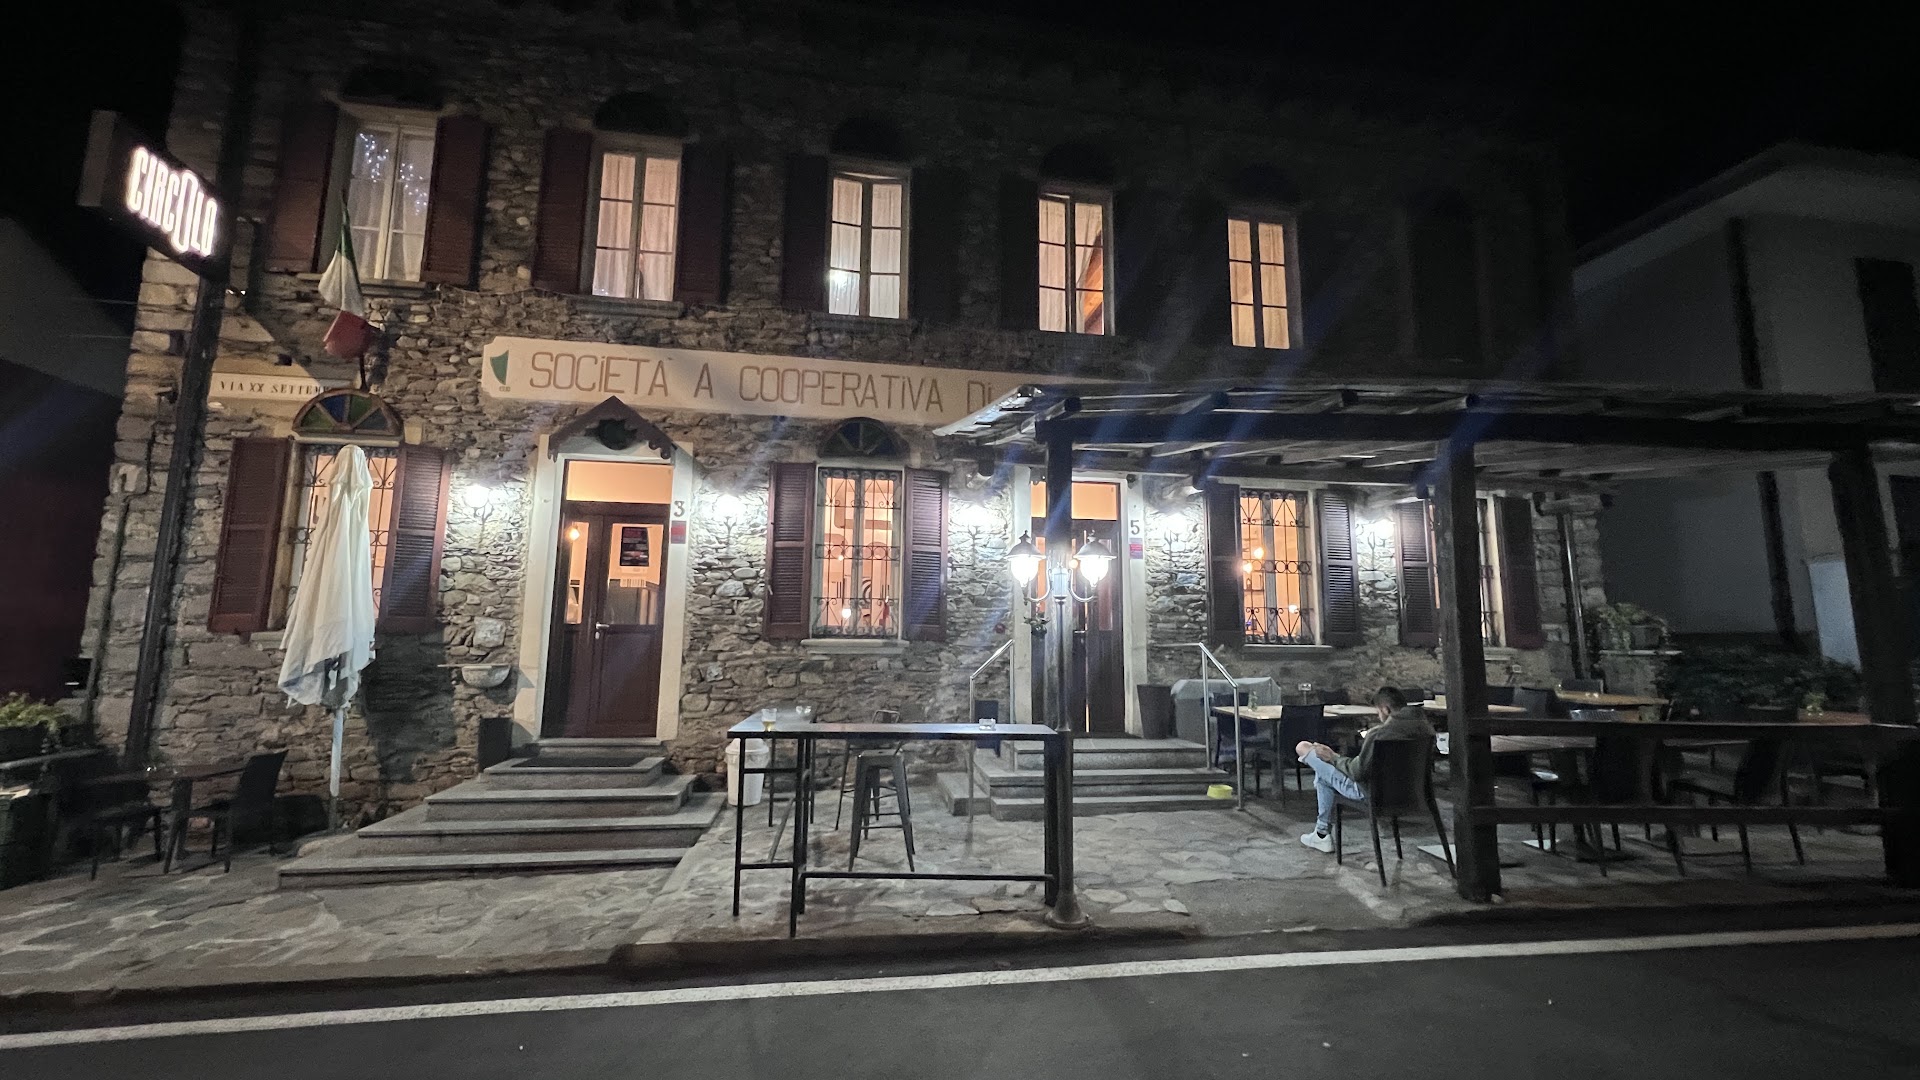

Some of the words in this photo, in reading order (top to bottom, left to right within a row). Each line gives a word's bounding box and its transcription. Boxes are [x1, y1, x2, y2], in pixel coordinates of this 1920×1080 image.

[127, 146, 218, 257] CIRCOLO
[220, 381, 244, 391] VIA
[249, 382, 265, 394] XX
[693, 362, 713, 398] A
[674, 500, 685, 517] 3
[1130, 519, 1140, 535] 5
